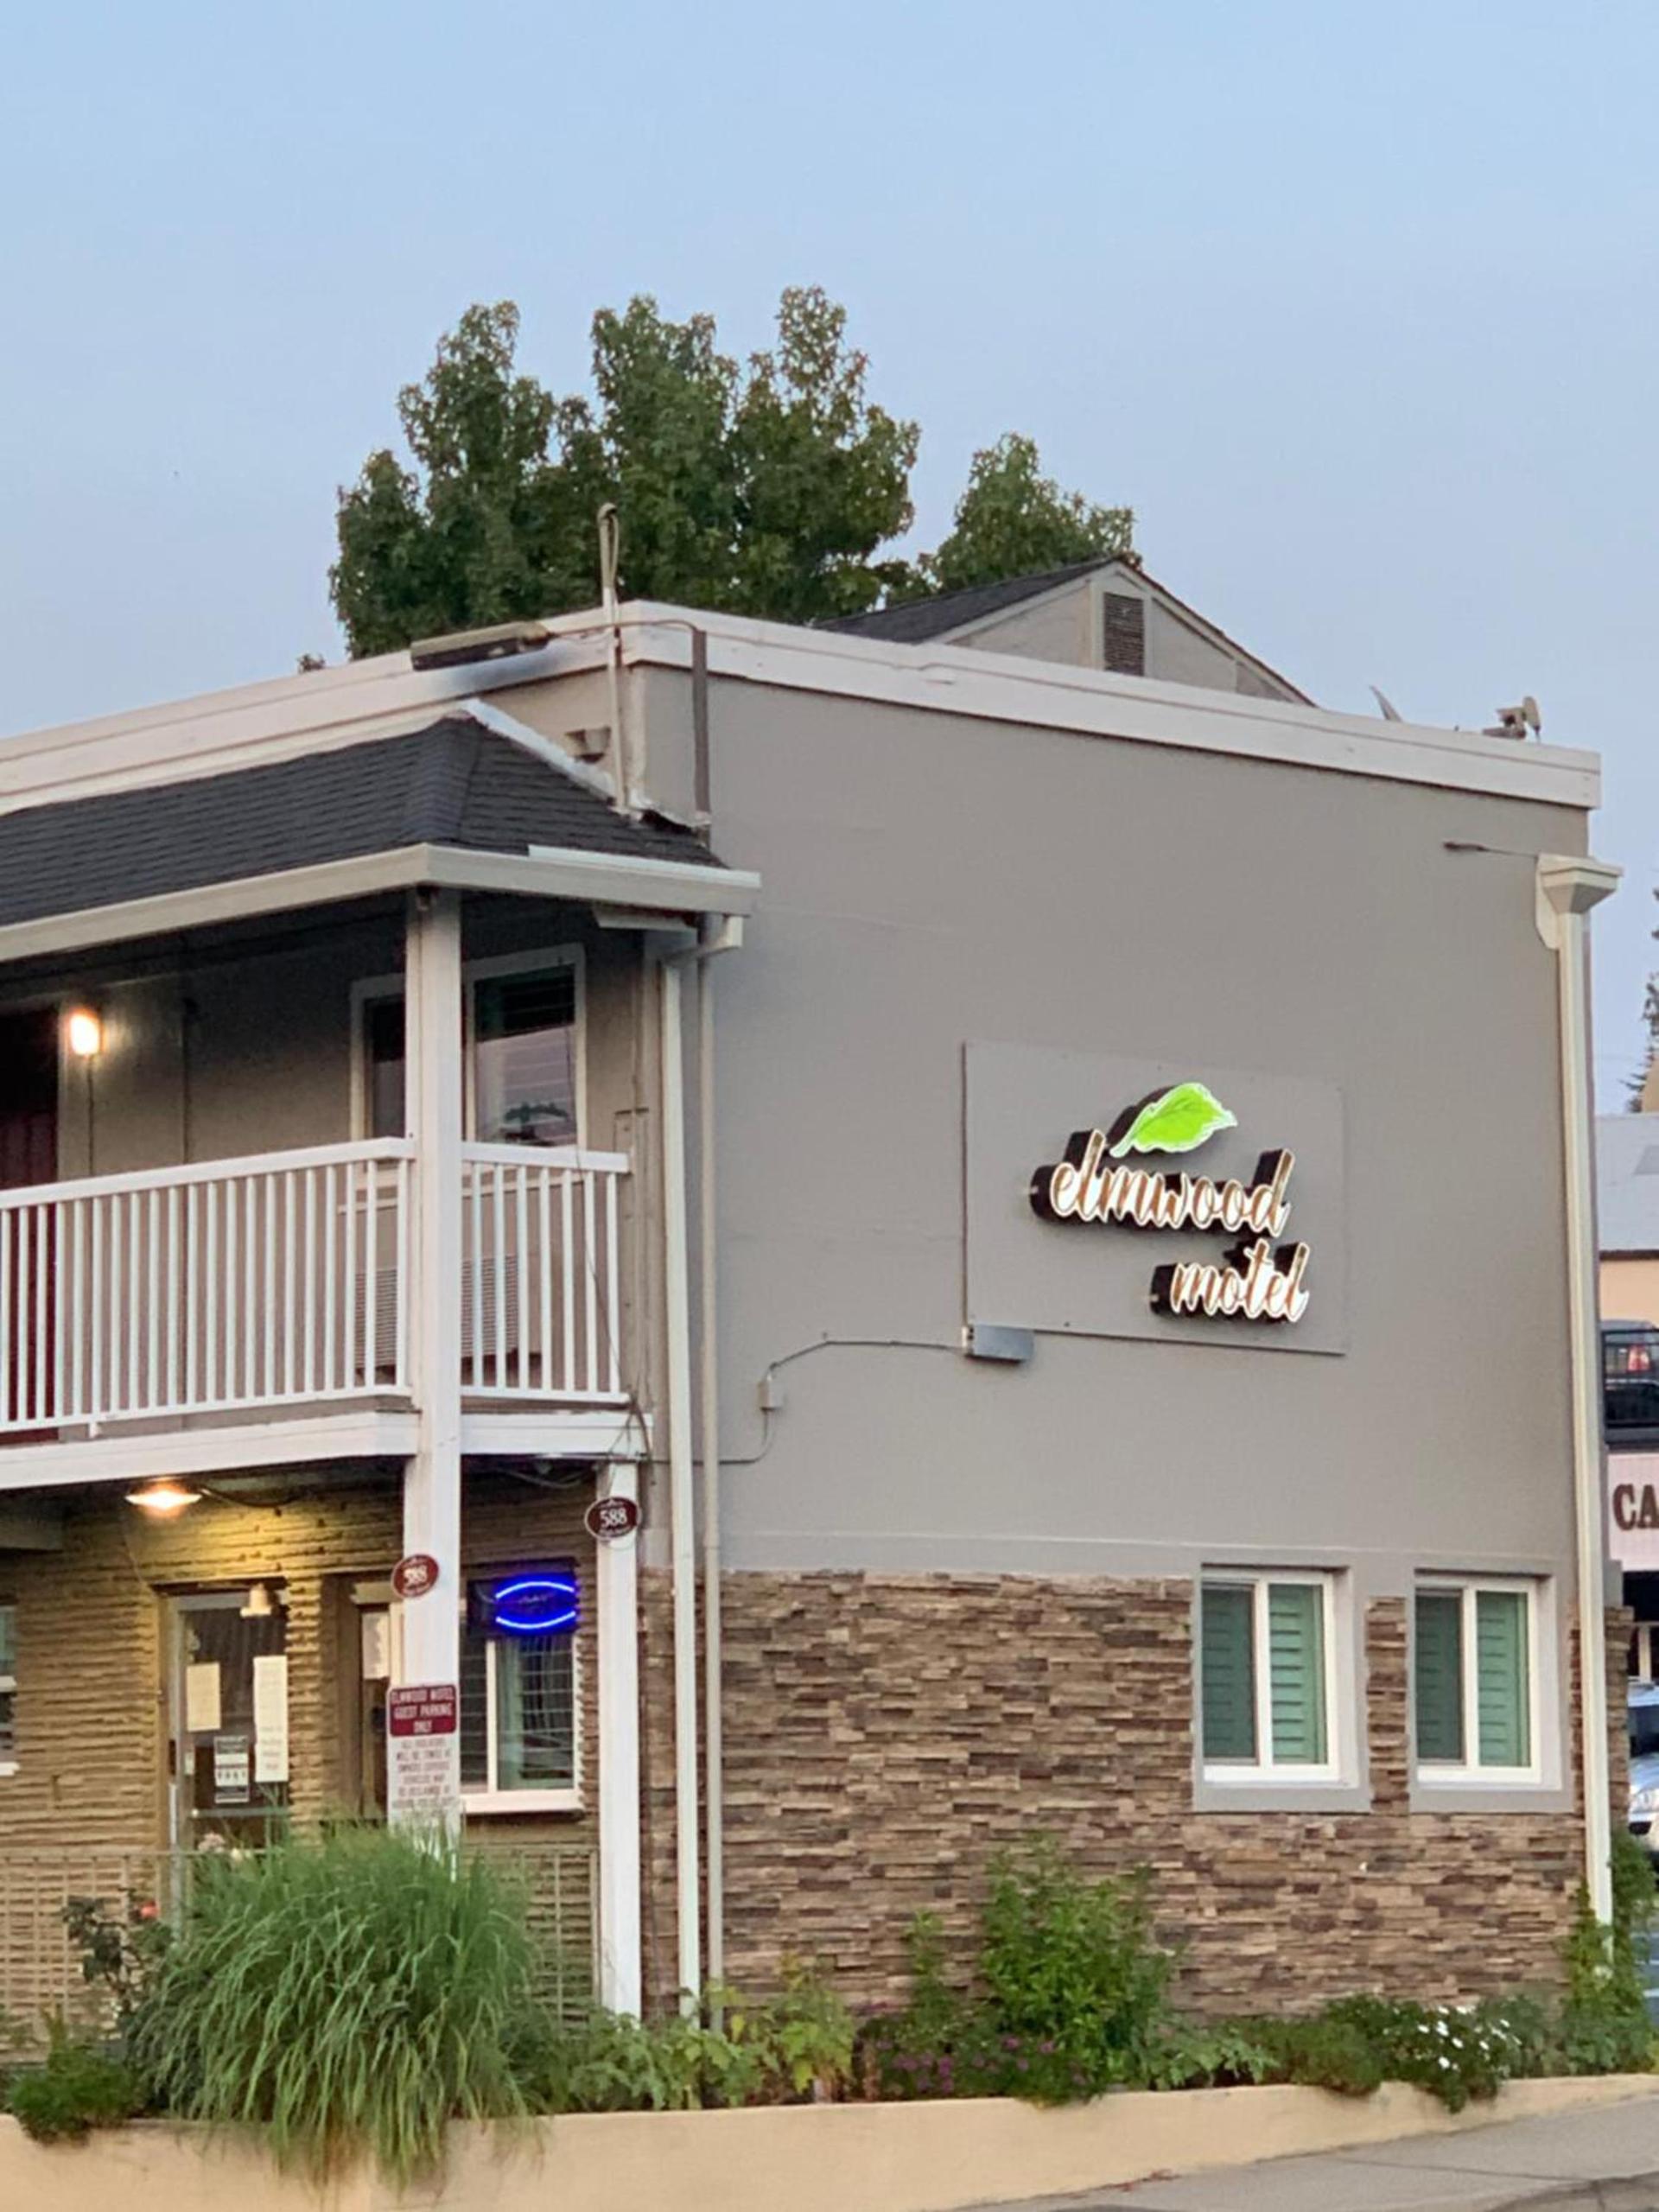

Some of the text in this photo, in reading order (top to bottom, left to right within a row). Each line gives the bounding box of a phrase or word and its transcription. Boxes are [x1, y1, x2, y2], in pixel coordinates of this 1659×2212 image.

[1049, 1128, 1295, 1237] elmwood
[1169, 1237, 1310, 1322] motel
[600, 1507, 627, 1529] 588
